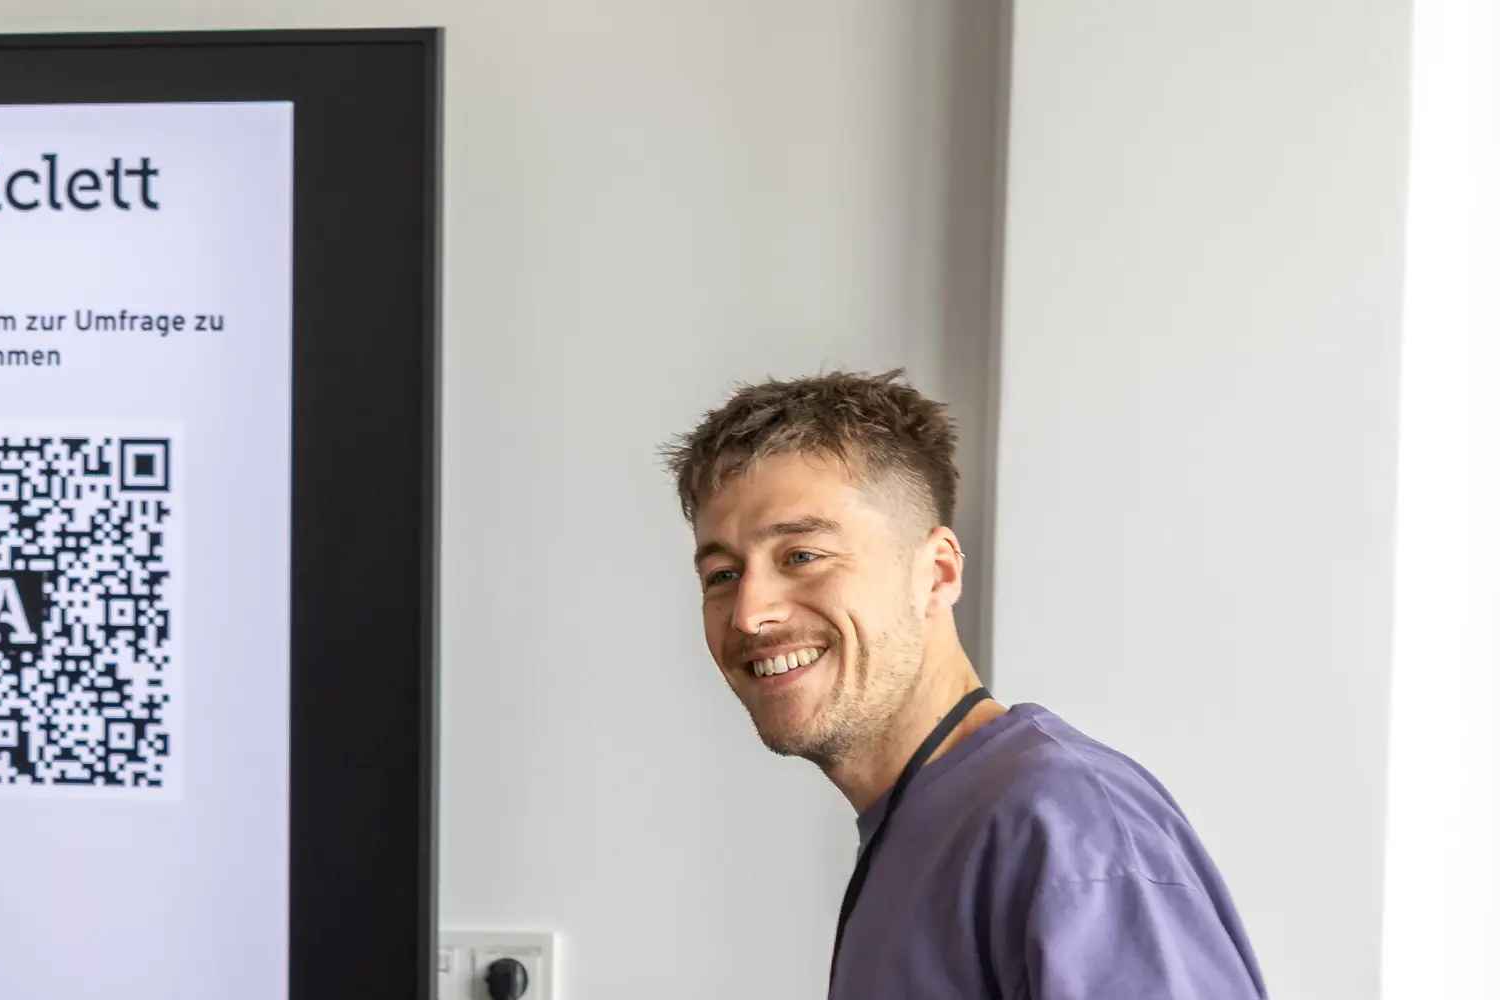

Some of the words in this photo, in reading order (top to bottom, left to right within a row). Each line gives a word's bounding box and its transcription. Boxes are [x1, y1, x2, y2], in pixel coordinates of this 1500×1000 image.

[24, 314, 68, 333] zur
[74, 309, 187, 338] Umfrage
[193, 314, 225, 333] zu
